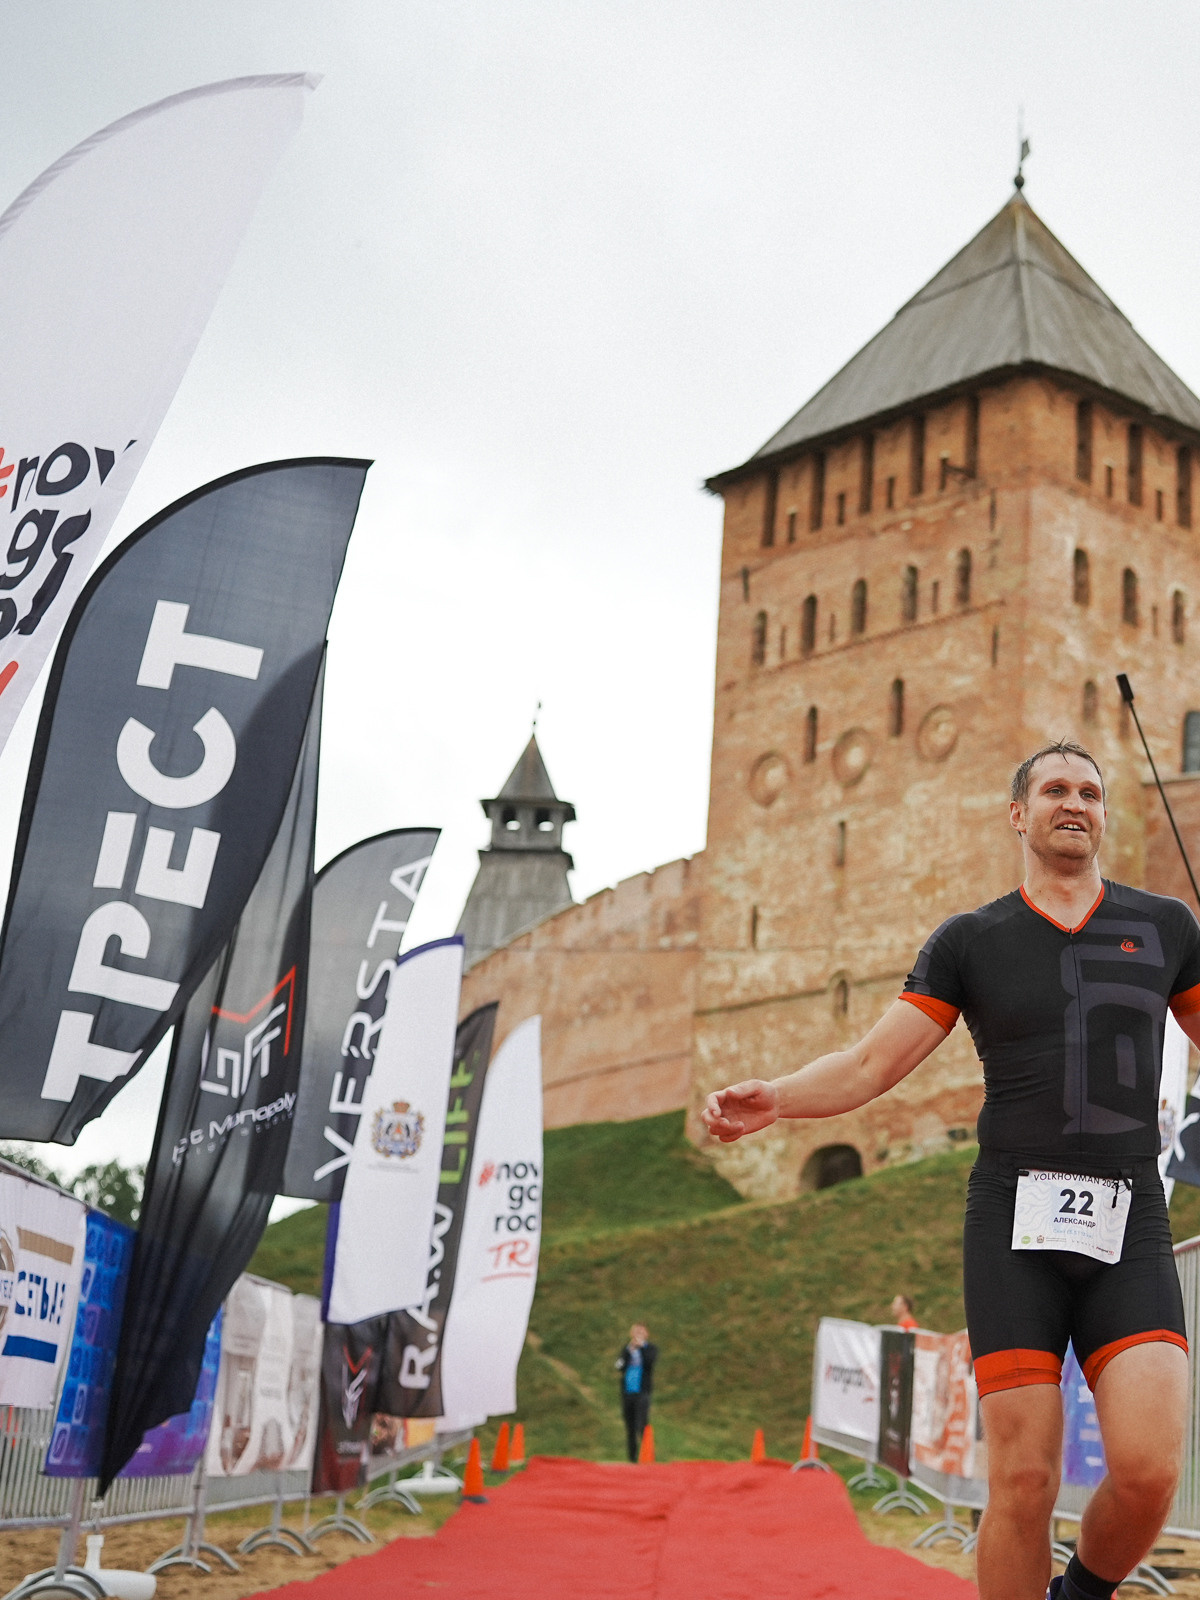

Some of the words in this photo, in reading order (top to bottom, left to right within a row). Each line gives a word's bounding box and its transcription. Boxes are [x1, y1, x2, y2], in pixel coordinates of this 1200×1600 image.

[313, 855, 432, 1181] VERSTA
[1033, 1172, 1100, 1185] VOLKHOVMAN
[1058, 1188, 1094, 1217] 22
[1053, 1216, 1097, 1229] АЛЕКСАНДР
